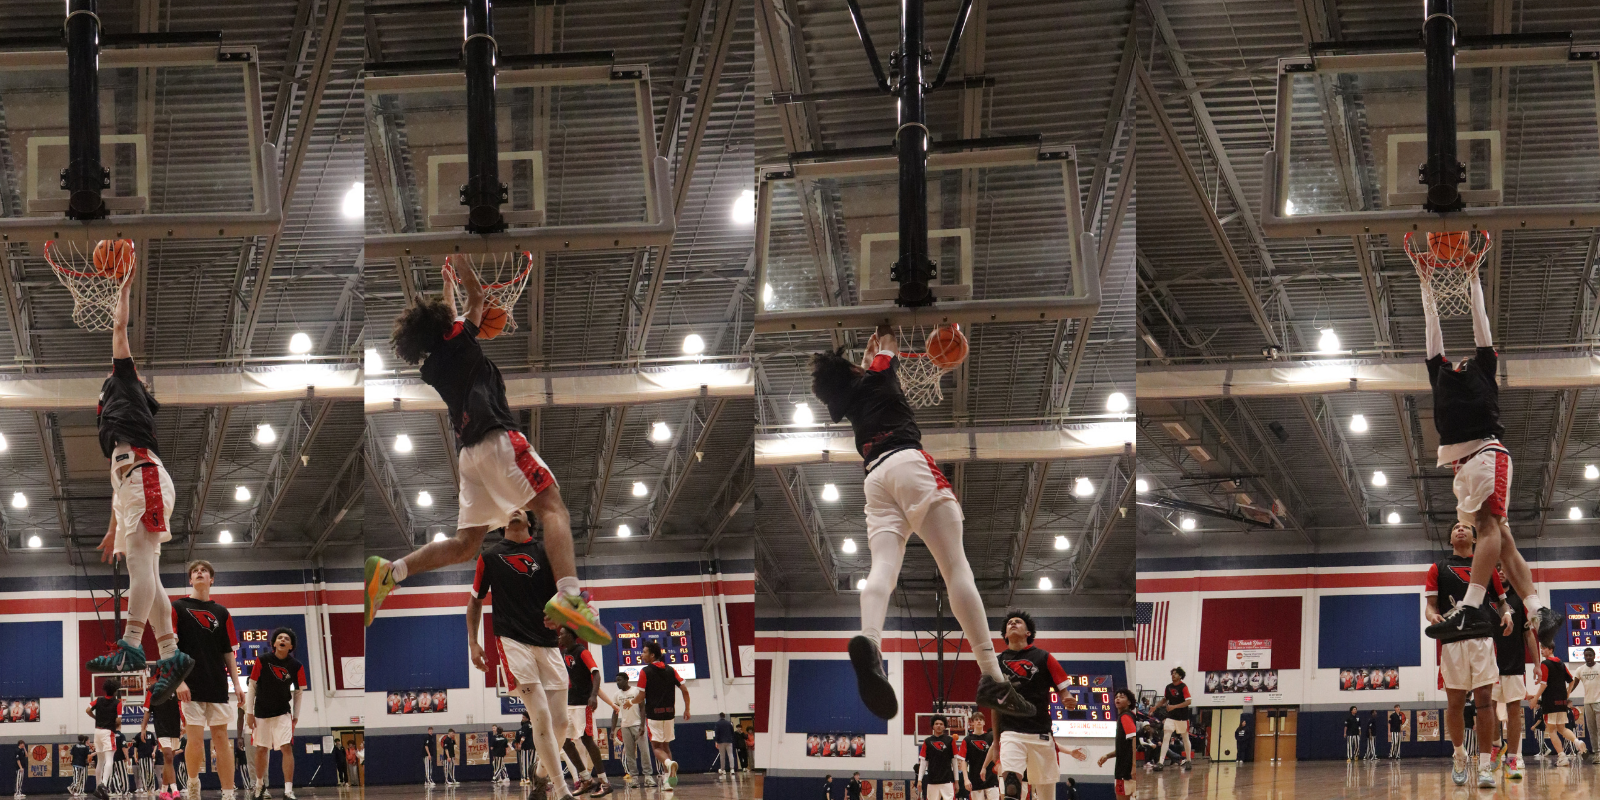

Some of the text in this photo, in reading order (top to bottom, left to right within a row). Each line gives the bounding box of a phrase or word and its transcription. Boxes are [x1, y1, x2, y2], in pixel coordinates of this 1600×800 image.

[642, 620, 666, 630] 19:00
[1580, 620, 1586, 630] 0
[244, 630, 268, 641] 18:32
[630, 638, 637, 648] 0
[680, 636, 687, 646] 0
[1253, 640, 1263, 648] You
[1586, 637, 1591, 645] 5
[626, 656, 631, 664] 0
[670, 654, 676, 663] 5
[684, 654, 688, 662] 0
[1051, 693, 1058, 702] 0
[1102, 694, 1109, 704] 0
[1056, 711, 1062, 720] 5
[1092, 711, 1098, 720] 5
[1105, 711, 1110, 720] 0
[468, 743, 488, 752] TYLER
